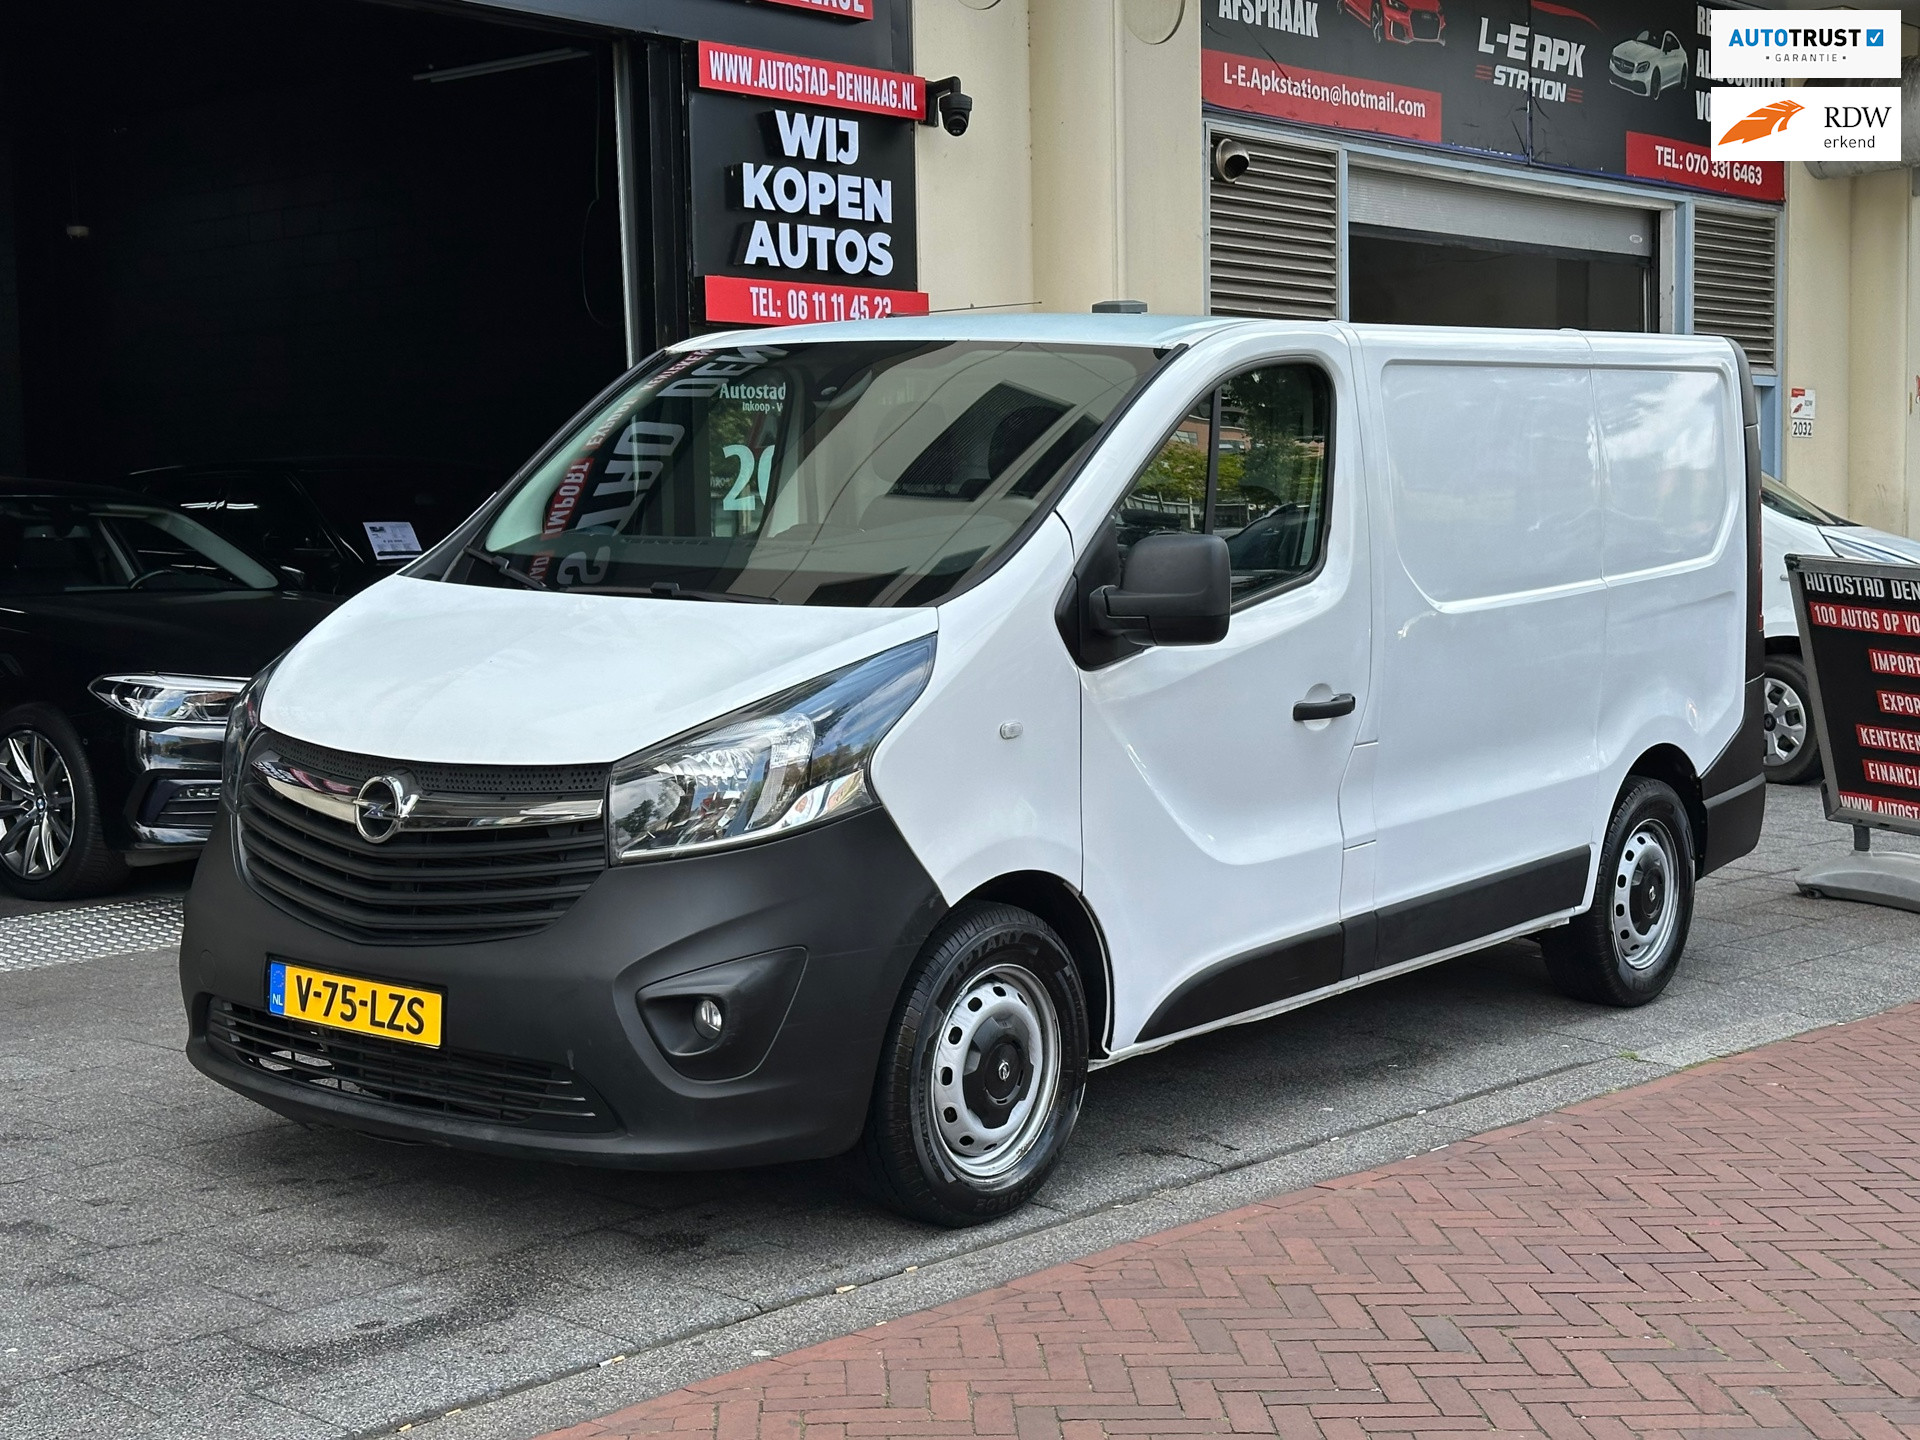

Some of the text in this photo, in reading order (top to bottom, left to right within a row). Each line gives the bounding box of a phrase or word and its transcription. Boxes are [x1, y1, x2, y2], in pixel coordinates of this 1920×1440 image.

[1478, 16, 1586, 78] L-E APK
[708, 49, 918, 111] WWW.AUTOSTAD-DENHAAG.NL
[1223, 62, 1426, 118] L-E.Apkstation@hotmail.com
[1493, 64, 1567, 103] STATION
[774, 109, 860, 165] WIJ
[1654, 145, 1763, 186] TEL: 070 331 6463
[742, 162, 893, 224] KOPEN
[743, 220, 894, 276] AUTOS
[749, 286, 782, 318] TEL:
[787, 289, 808, 320] 06
[812, 291, 827, 321] 11
[831, 292, 845, 322] 11
[849, 294, 870, 321] 45
[719, 382, 787, 400] Autostad
[1793, 421, 1812, 436] 2032
[1804, 572, 1885, 598] AUTOSTAD
[1814, 605, 1837, 625] 100
[1841, 608, 1880, 630] AUTOS
[1882, 612, 1900, 632] OP
[272, 993, 284, 1007] NL
[296, 974, 425, 1036] V-75-LZS
